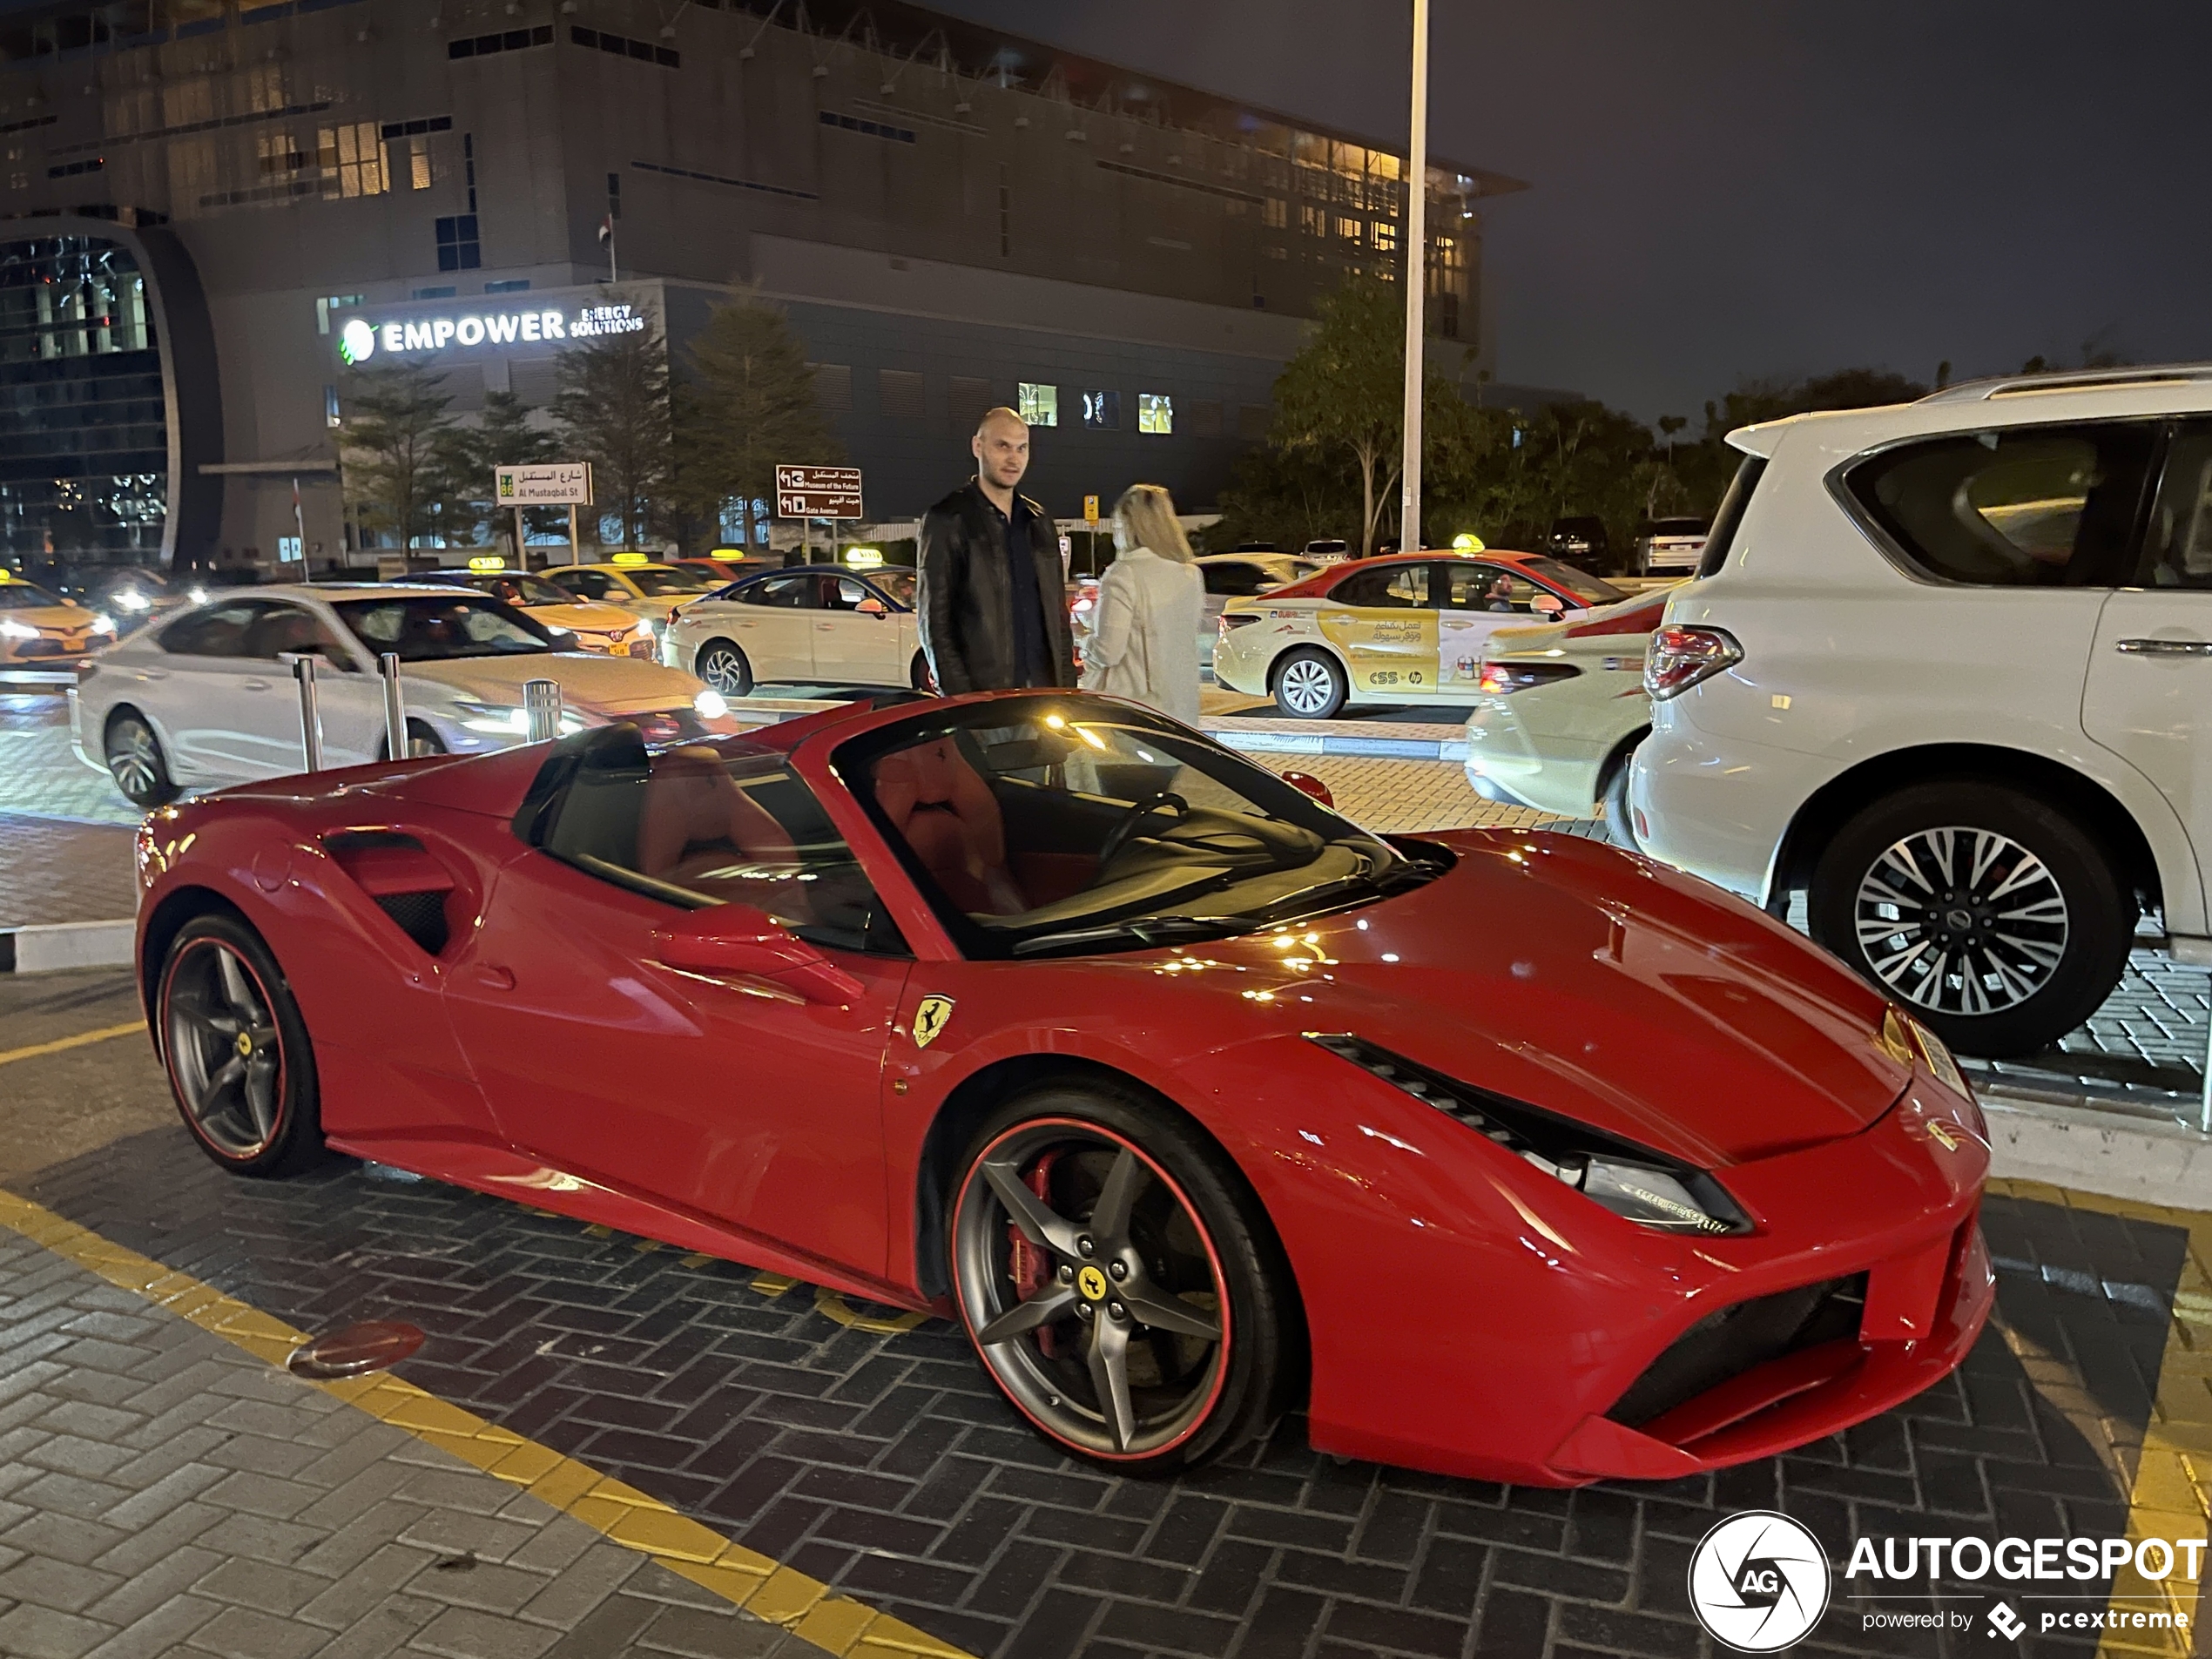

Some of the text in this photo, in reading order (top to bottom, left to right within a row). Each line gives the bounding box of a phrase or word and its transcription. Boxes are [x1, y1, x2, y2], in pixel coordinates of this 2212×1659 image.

[581, 305, 631, 322] ENERGY
[383, 311, 566, 353] EMPOWER
[570, 317, 644, 338] SOLUTIONS
[519, 470, 582, 483] شارع المستقبل
[501, 484, 513, 496] 86
[519, 489, 527, 497] Al
[529, 489, 568, 499] Mustaqbal
[1370, 671, 1422, 685] CSS hp
